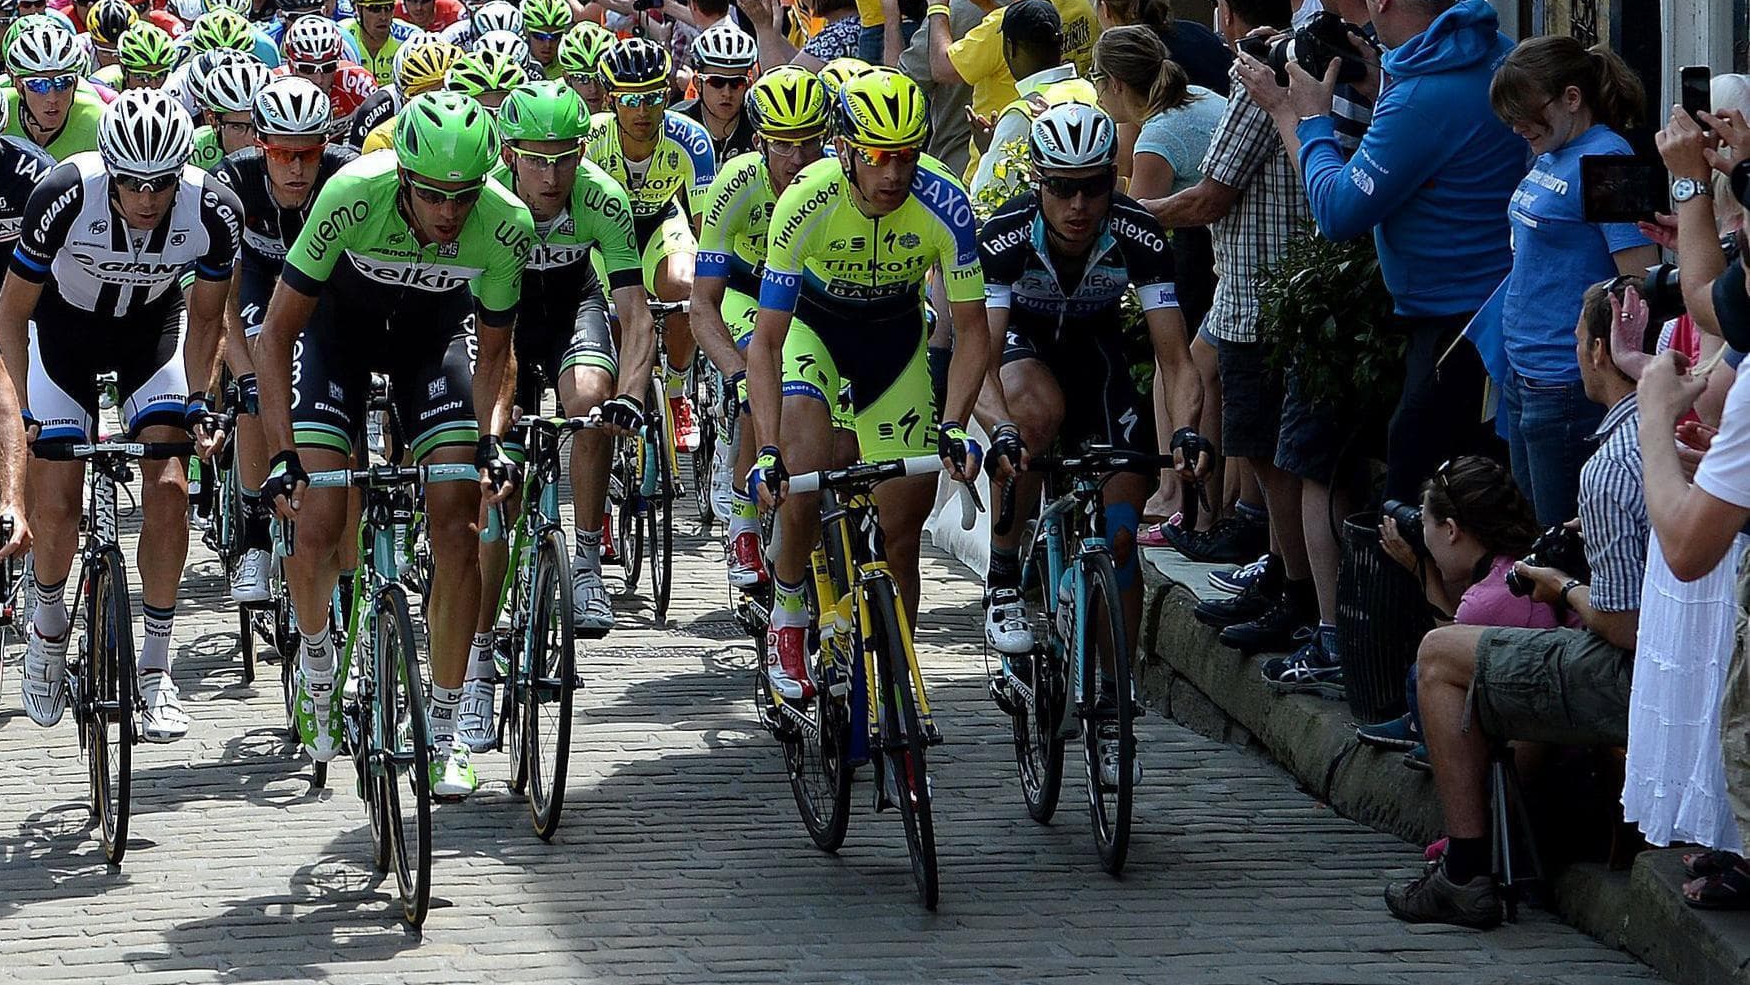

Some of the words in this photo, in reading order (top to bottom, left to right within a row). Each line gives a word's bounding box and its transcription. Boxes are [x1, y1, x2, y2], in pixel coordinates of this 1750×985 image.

[365, 100, 392, 129] GIANT
[666, 117, 709, 156] SAXO
[40, 184, 80, 231] GIANT
[911, 171, 971, 228] SAXO
[216, 205, 241, 249] GIANT
[305, 199, 370, 262] wemo
[982, 220, 1035, 256] latexc
[1110, 217, 1165, 253] atexco
[696, 253, 726, 264] AXO
[823, 255, 925, 273] Tinkoff
[762, 268, 796, 288] SAXO
[147, 393, 187, 404] SHIMAN
[420, 400, 463, 421] Bianchi
